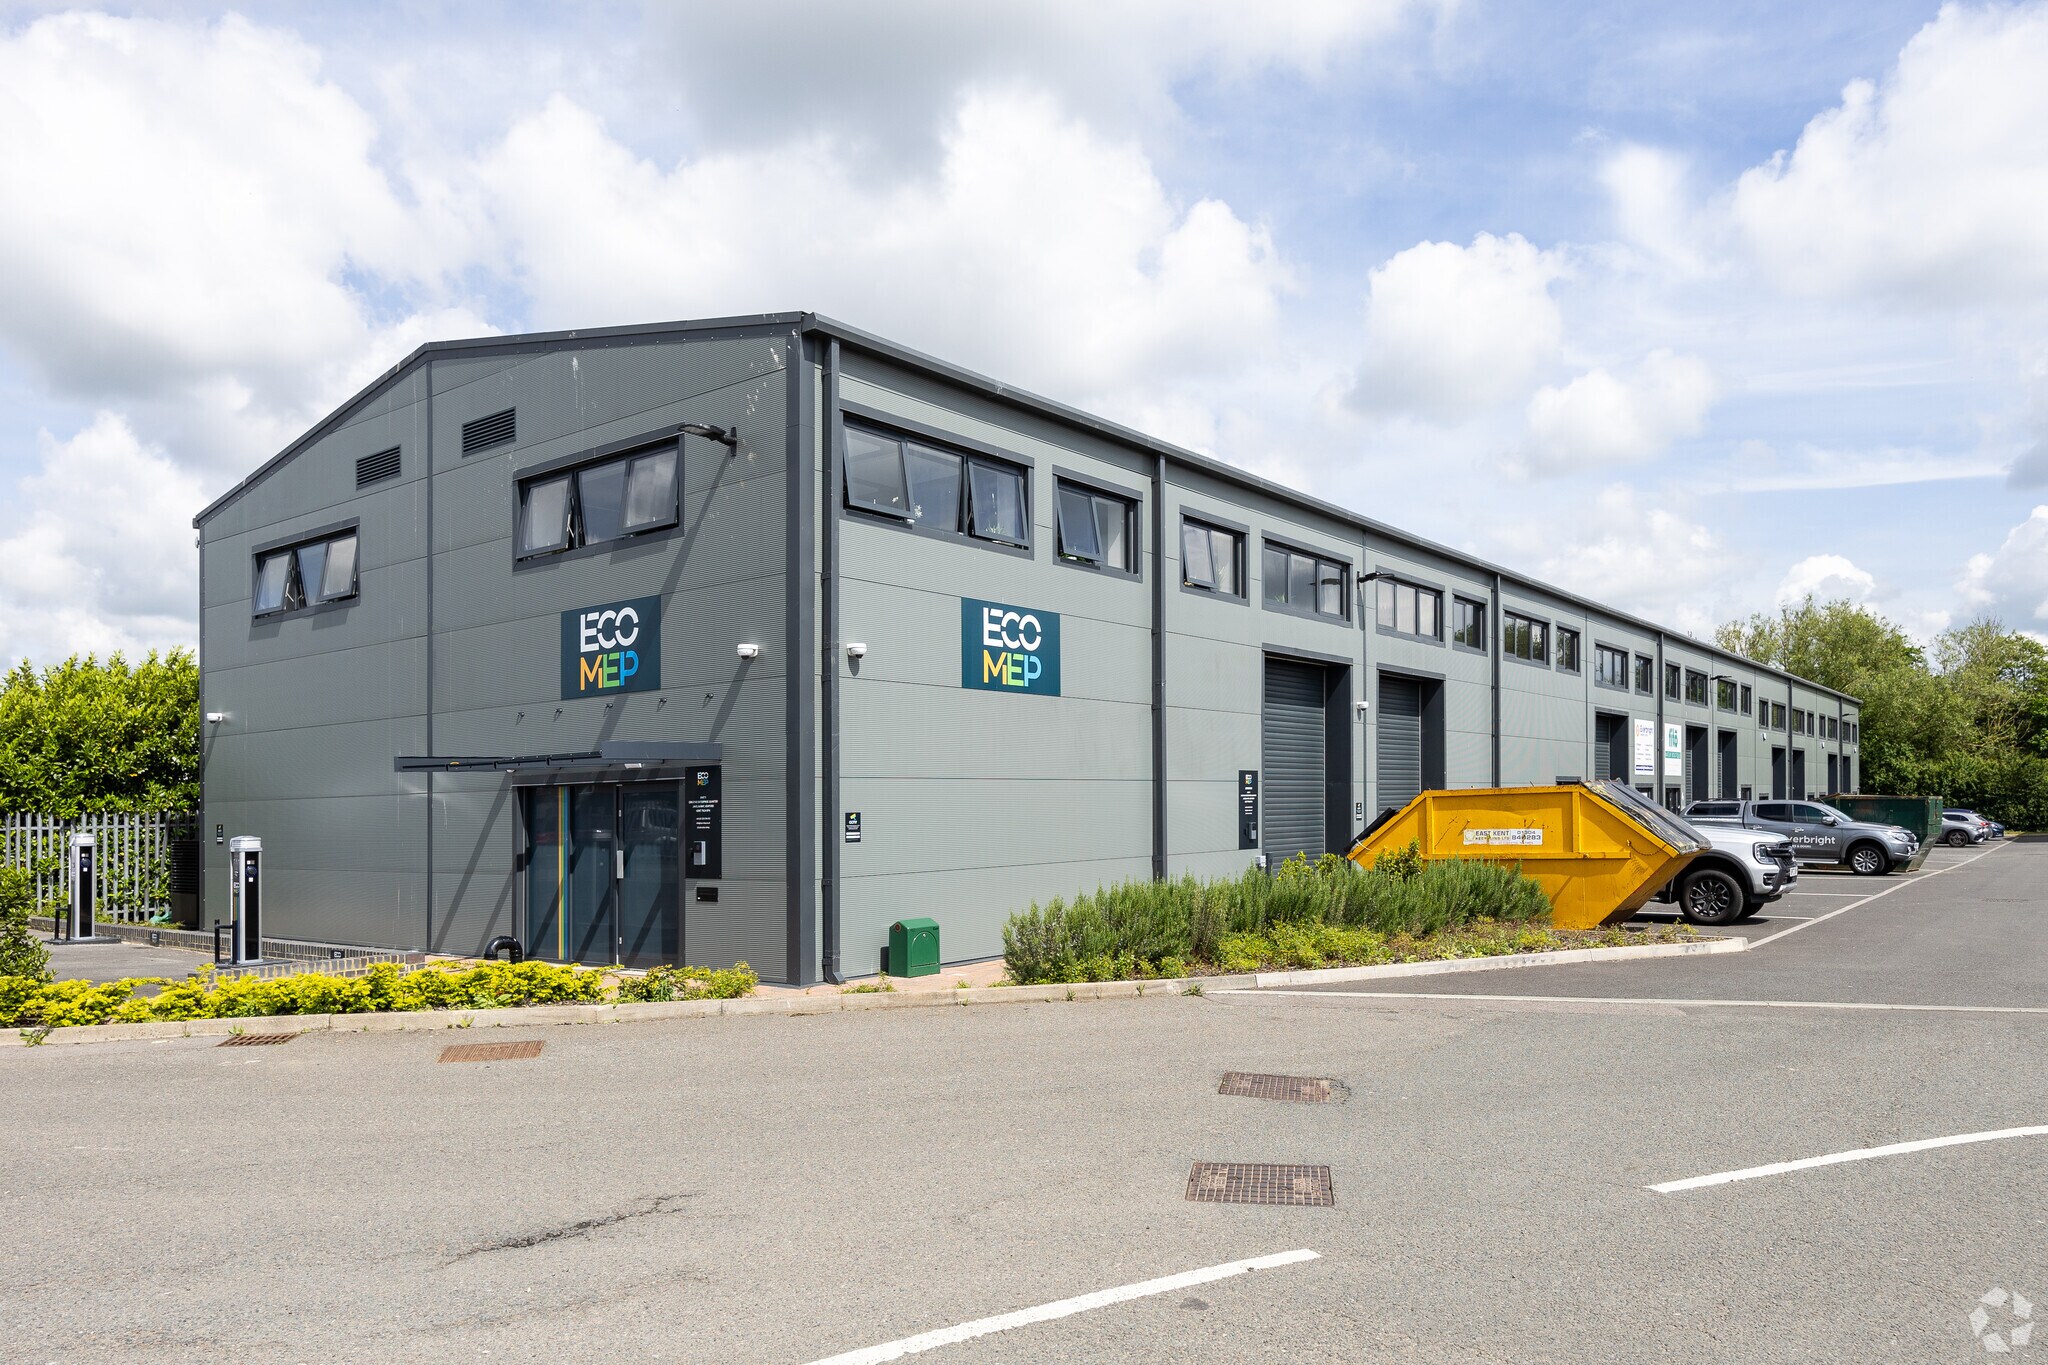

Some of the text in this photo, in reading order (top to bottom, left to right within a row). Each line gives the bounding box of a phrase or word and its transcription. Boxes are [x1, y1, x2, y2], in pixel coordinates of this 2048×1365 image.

[580, 607, 639, 653] ECO
[983, 607, 1042, 652] ECO
[580, 650, 639, 691] MEP
[983, 649, 1042, 687] MEP
[1788, 835, 1836, 845] verbright
